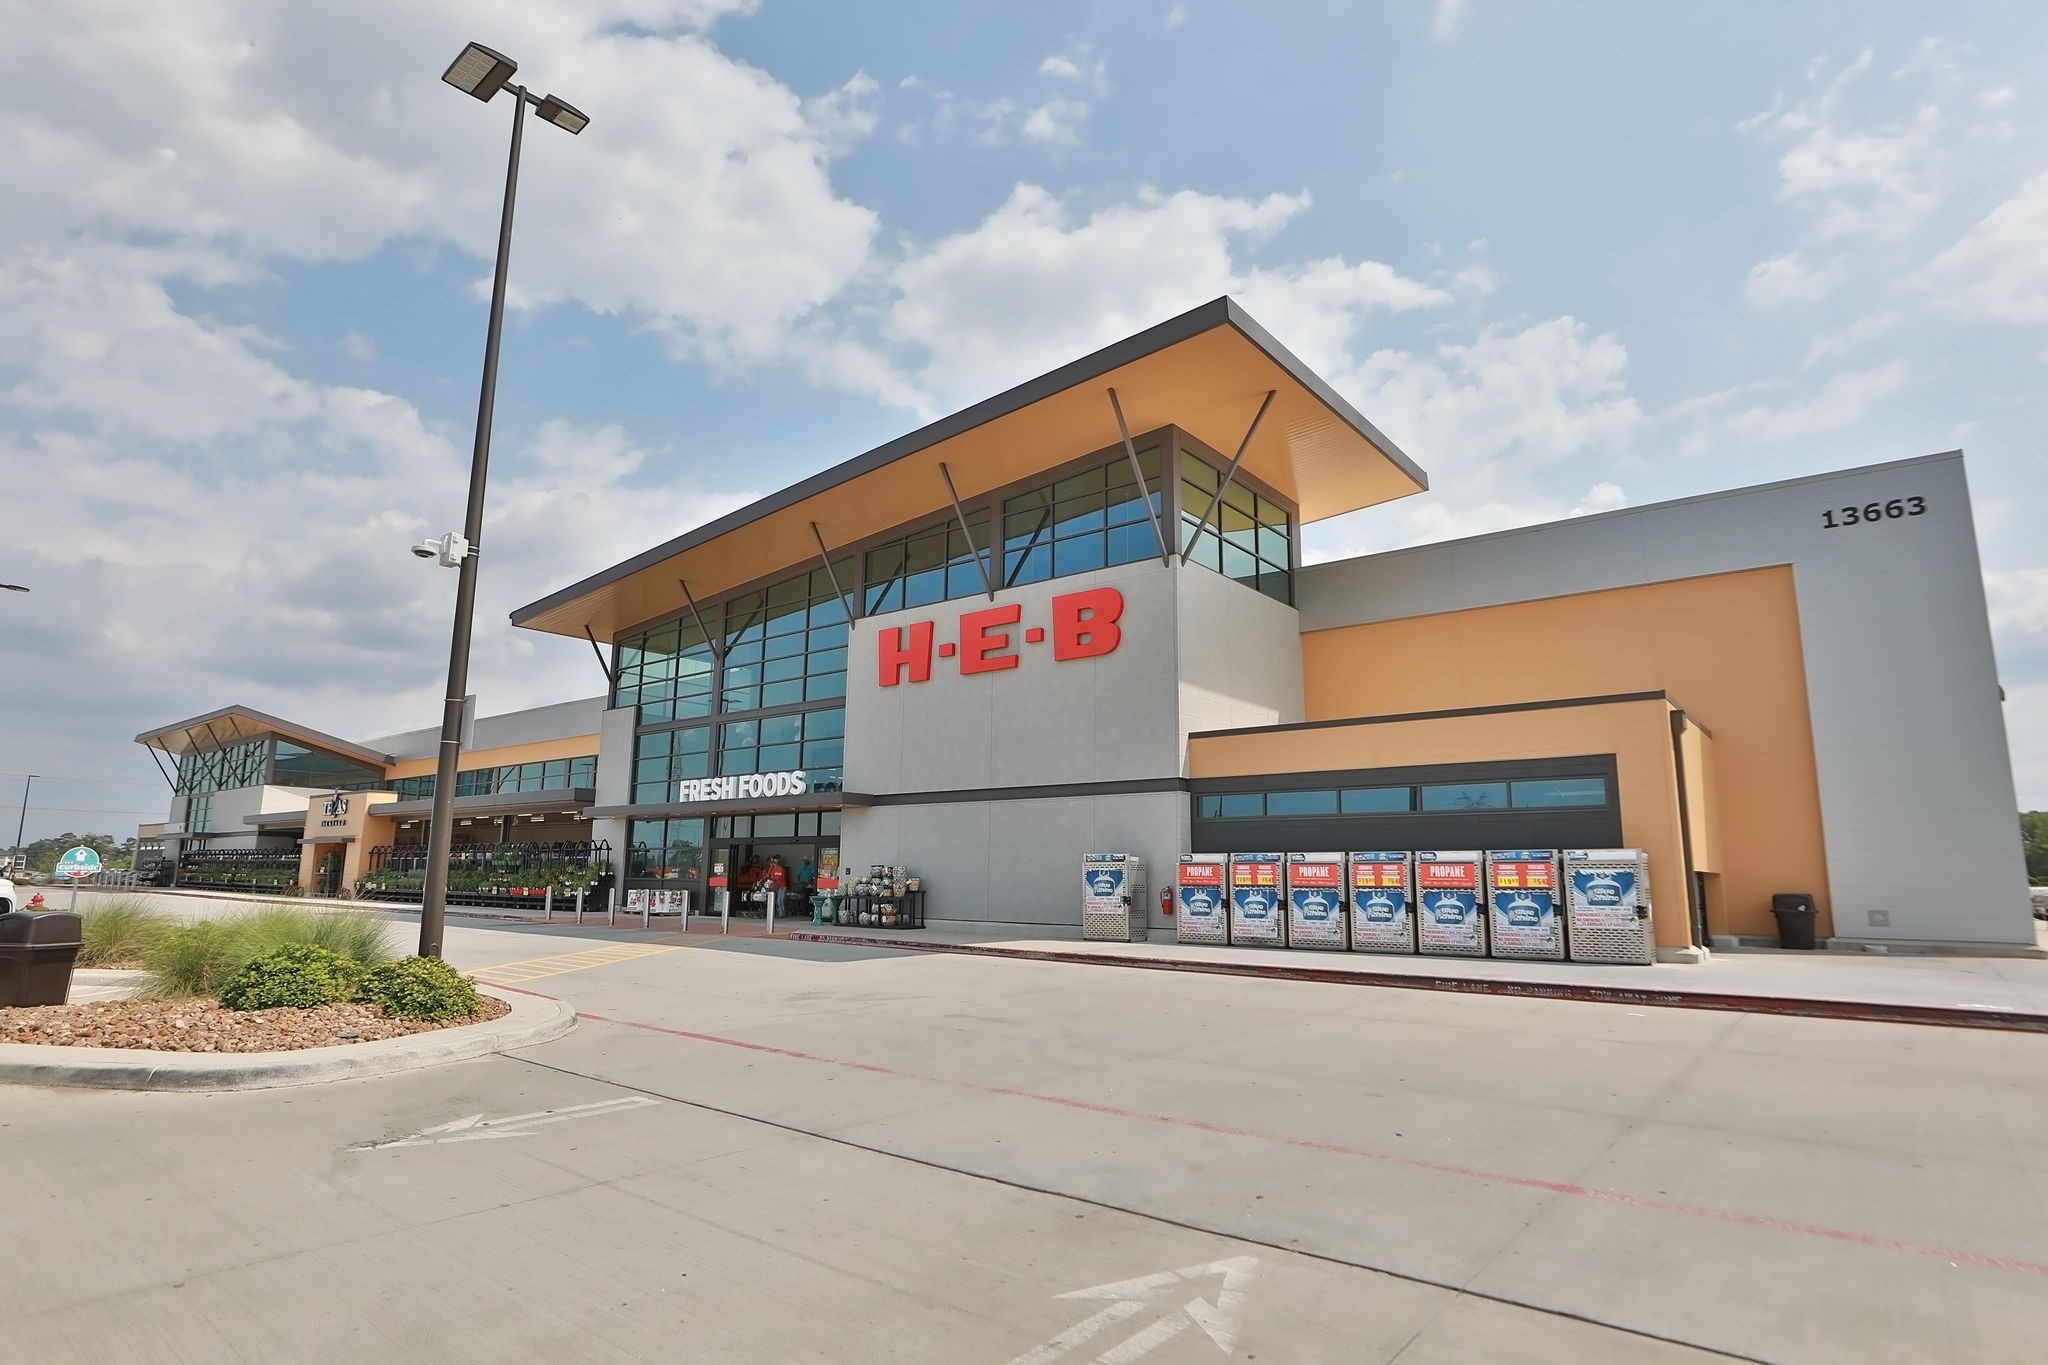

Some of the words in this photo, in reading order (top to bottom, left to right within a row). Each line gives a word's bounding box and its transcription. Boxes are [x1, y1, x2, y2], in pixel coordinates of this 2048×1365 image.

[1821, 495, 1927, 529] 13663
[680, 776, 738, 803] FRESH
[738, 770, 807, 799] FOODS
[323, 799, 349, 816] TEAS
[58, 863, 100, 871] curbside
[1186, 866, 1213, 877] PROPANE
[1298, 866, 1330, 877] PROPANE
[1429, 865, 1465, 878] PROPANE
